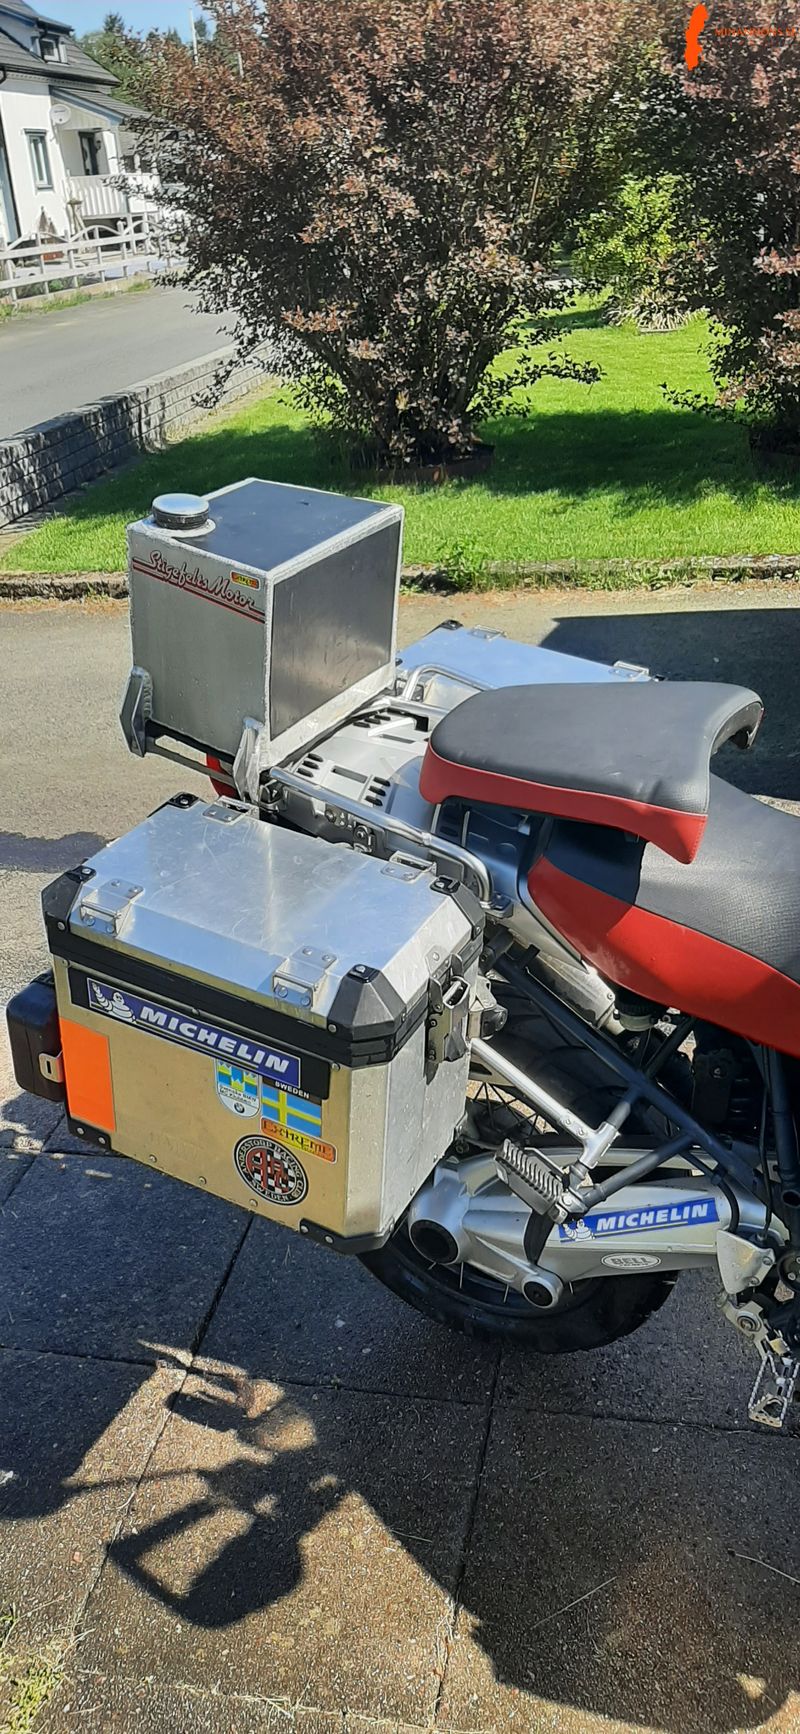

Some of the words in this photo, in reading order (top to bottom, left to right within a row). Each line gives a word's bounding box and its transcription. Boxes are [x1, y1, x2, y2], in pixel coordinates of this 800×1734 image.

[207, 575, 255, 609] Motor
[140, 1006, 289, 1074] MICHELIN
[275, 1080, 309, 1099] SWEDEN
[239, 1139, 273, 1174] ANDERSTORP
[274, 1145, 302, 1178] RACING
[251, 1180, 290, 1202] SWEDEN
[596, 1203, 708, 1231] MICHELIN
[610, 1256, 651, 1265] BELL
